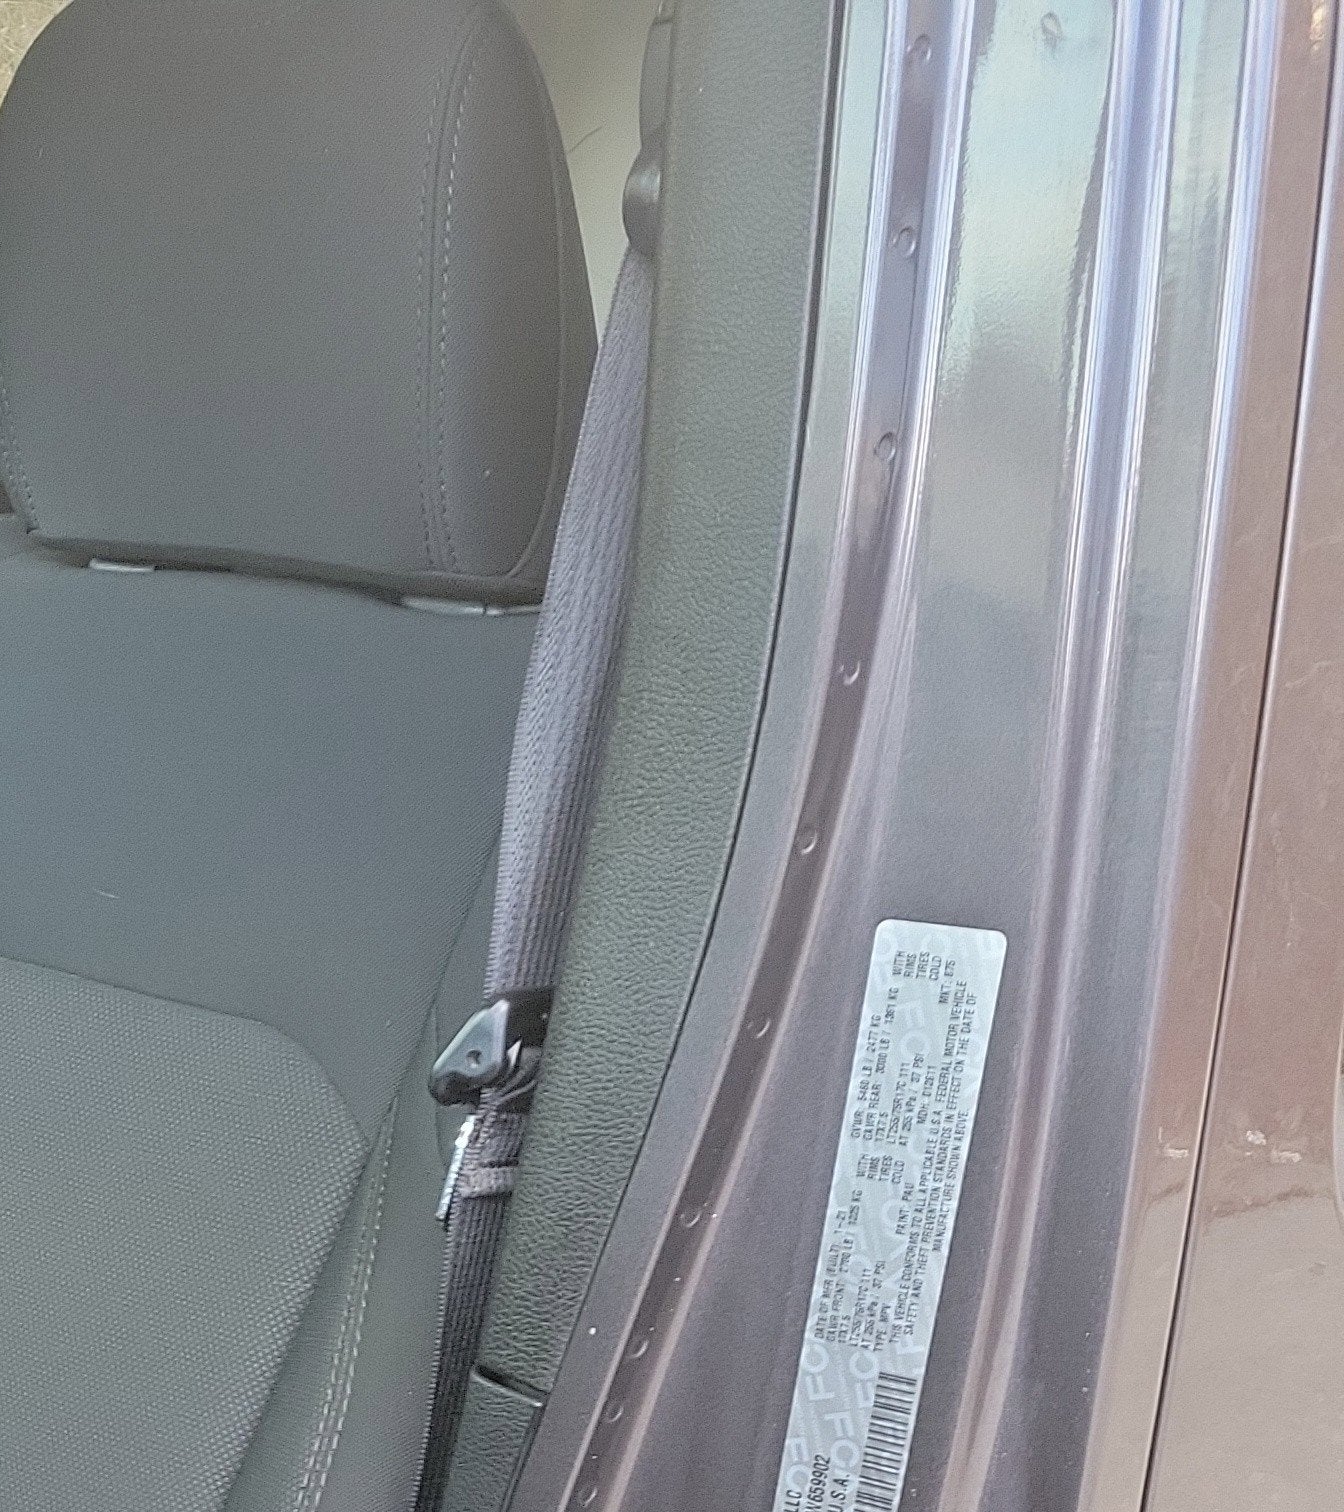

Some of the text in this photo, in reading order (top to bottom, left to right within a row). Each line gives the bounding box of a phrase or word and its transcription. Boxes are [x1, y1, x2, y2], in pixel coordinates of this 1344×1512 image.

[949, 979, 968, 1020] VEHICLE
[959, 1008, 976, 1033] DATE
[931, 1125, 953, 1183] STANDARDS
[920, 1184, 942, 1244] PREVENTION
[914, 1245, 930, 1276] THEFT
[909, 1277, 924, 1298] AND
[902, 1300, 920, 1336] SAFETY
